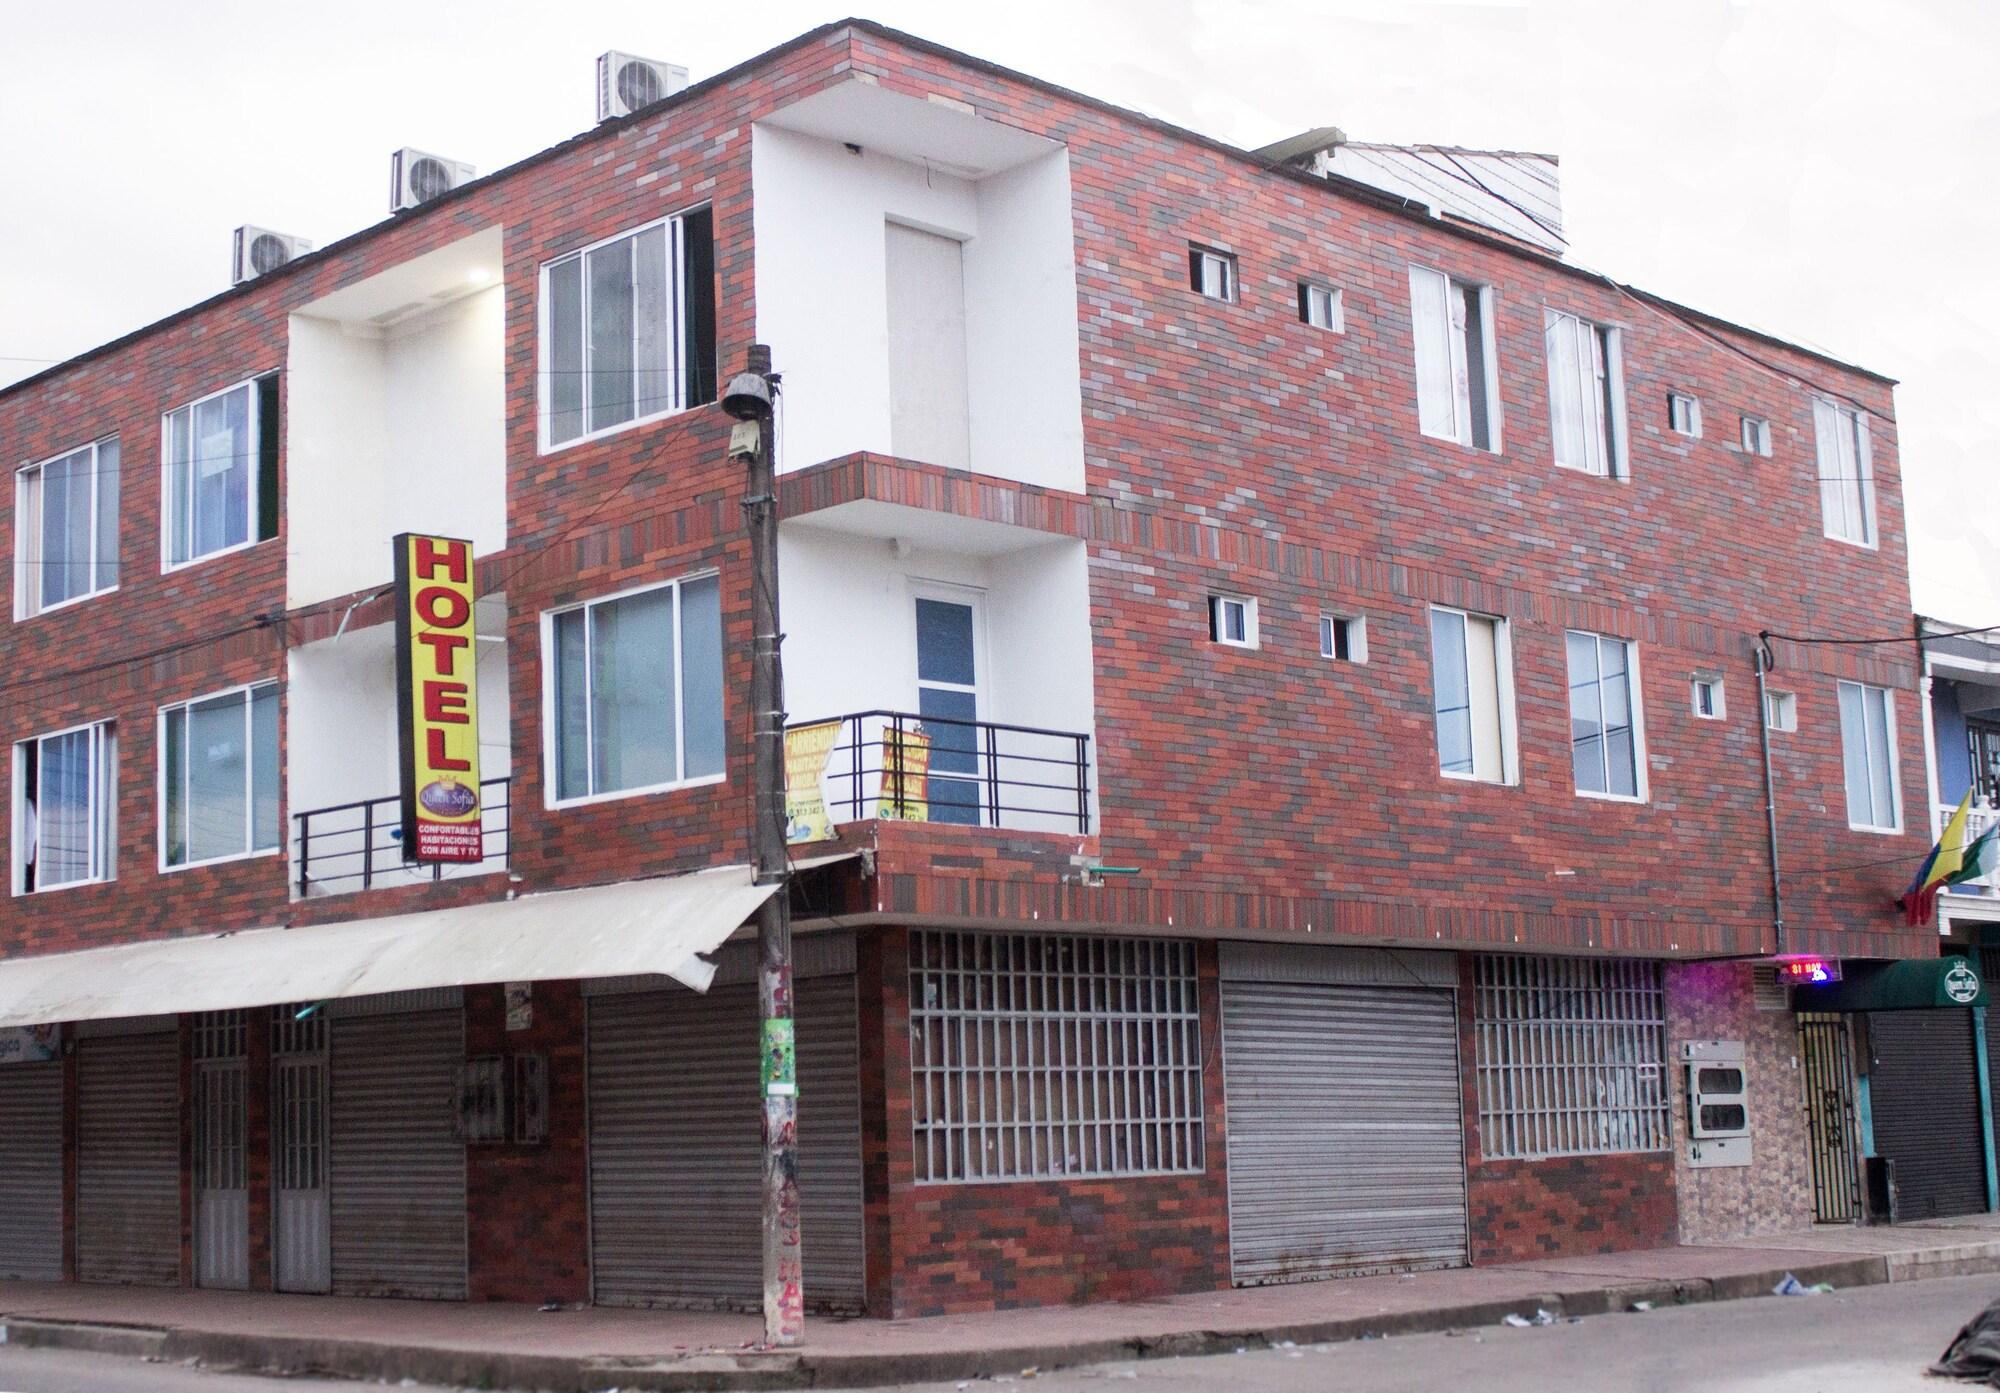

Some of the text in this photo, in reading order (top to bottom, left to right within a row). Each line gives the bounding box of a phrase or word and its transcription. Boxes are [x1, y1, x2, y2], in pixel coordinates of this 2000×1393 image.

[415, 537, 470, 773] HOTEL
[418, 826, 480, 835] CONFORTABLES
[420, 836, 478, 845] HABITACIONES
[421, 846, 479, 856] CON AIRE Y TV
